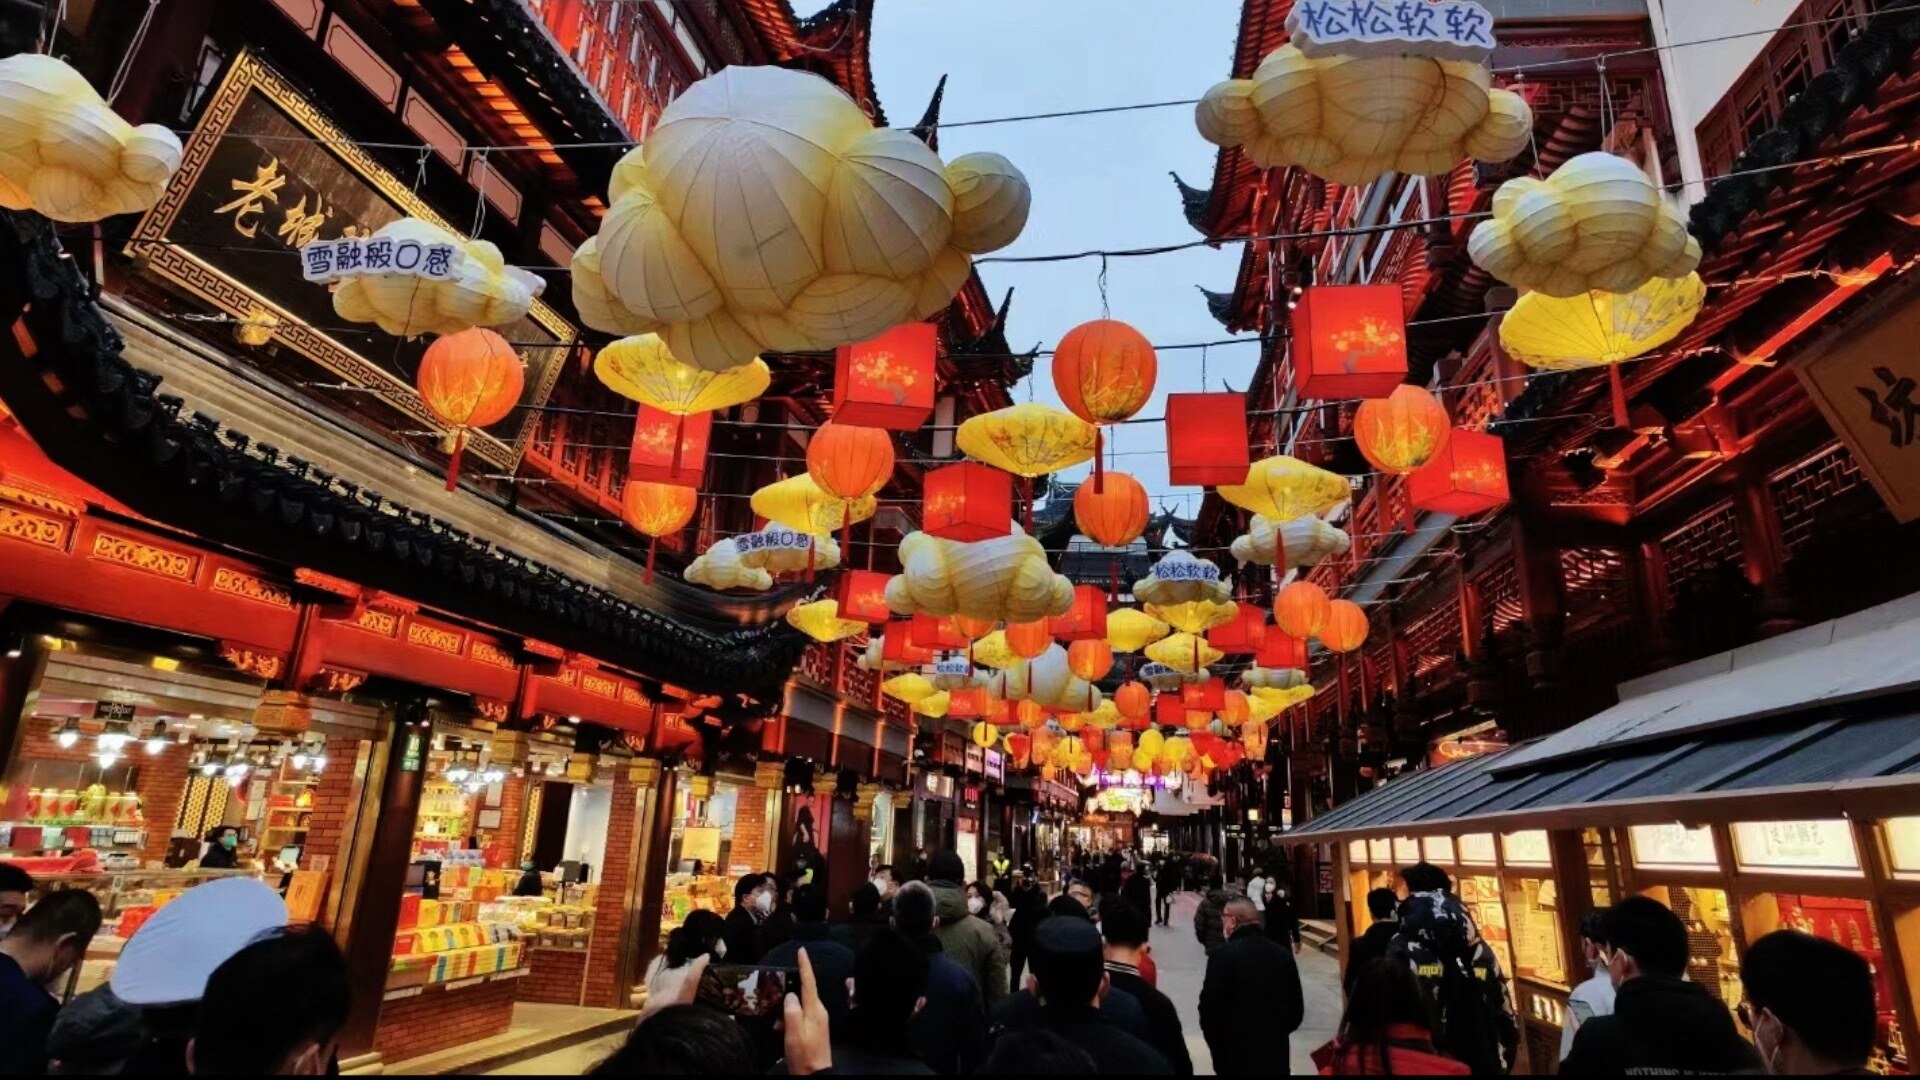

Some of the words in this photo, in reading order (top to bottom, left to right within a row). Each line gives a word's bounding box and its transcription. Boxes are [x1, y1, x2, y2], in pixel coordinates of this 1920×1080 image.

[1301, 1, 1487, 43] 松松软软
[1155, 561, 1217, 581] 松松软软
